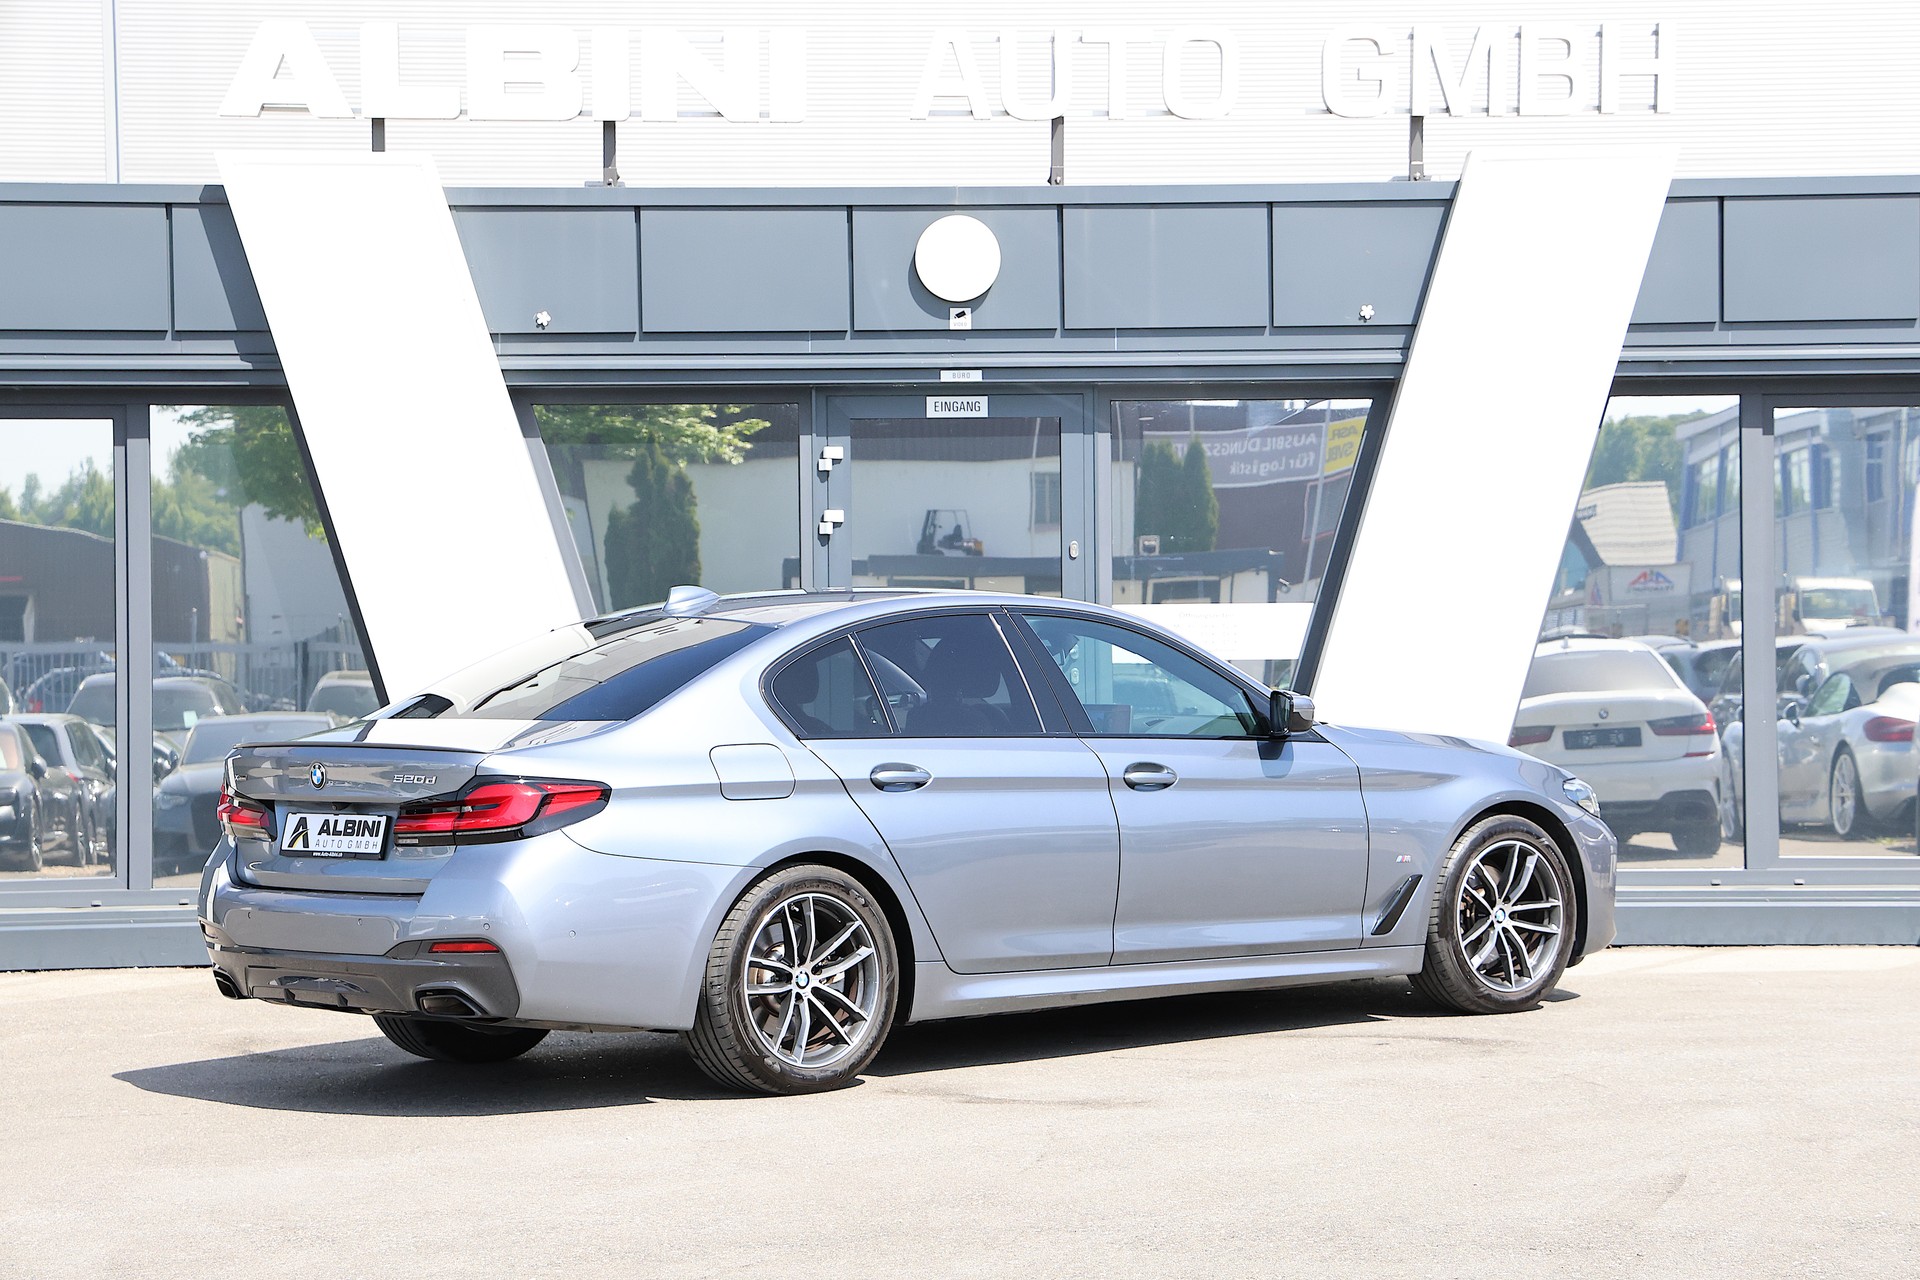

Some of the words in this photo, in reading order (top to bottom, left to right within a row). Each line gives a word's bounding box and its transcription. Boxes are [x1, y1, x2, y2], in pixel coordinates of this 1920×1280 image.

[218, 20, 806, 123] ALBINI
[909, 27, 1239, 121] AUTO
[1320, 22, 1677, 119] GMBH
[934, 401, 981, 412] EINGANG
[393, 774, 437, 785] 520d
[317, 819, 382, 837] ALBINI
[315, 839, 343, 849] AUTO
[347, 840, 378, 850] GMBH
